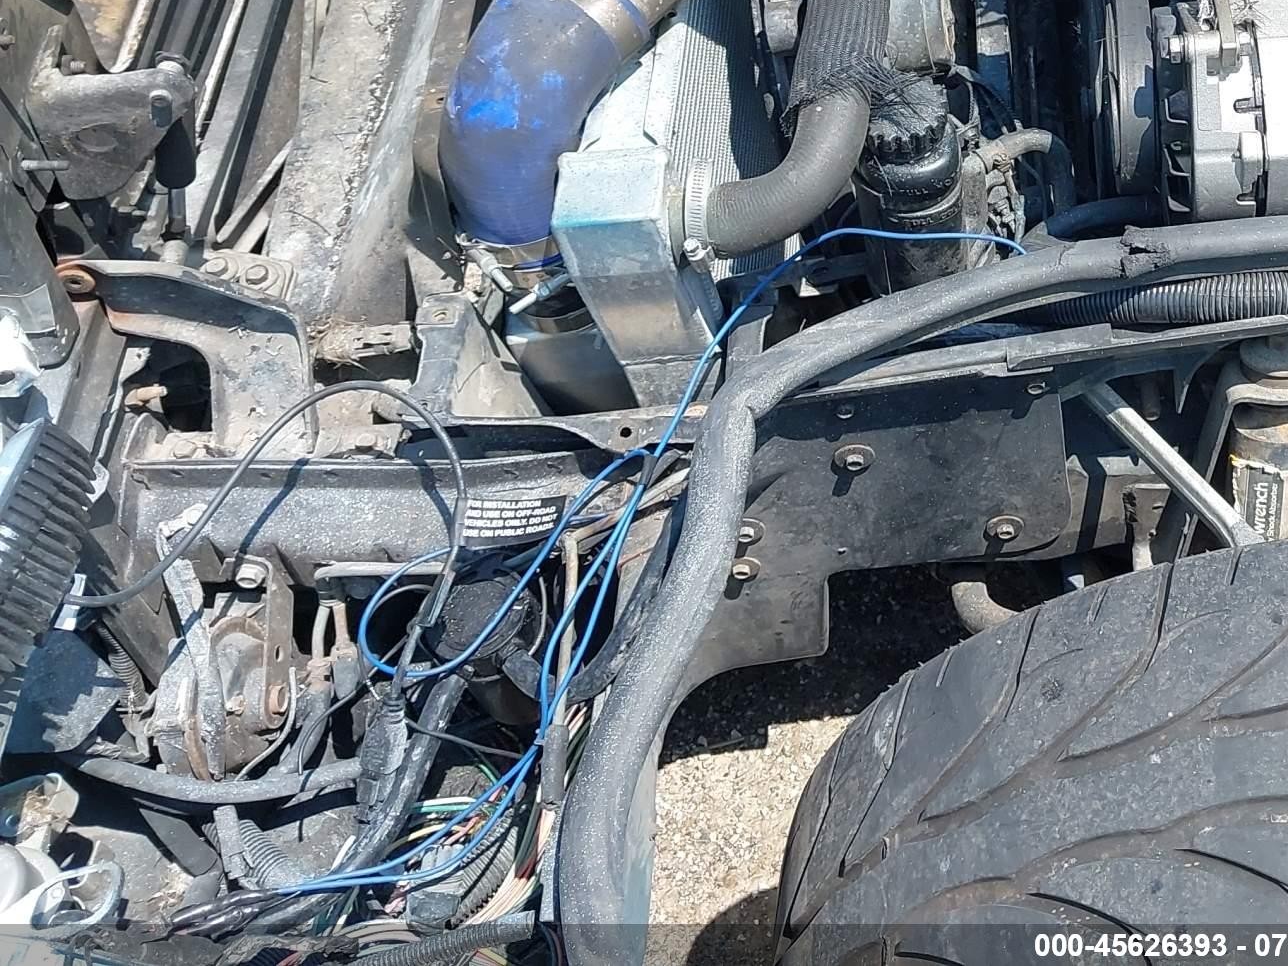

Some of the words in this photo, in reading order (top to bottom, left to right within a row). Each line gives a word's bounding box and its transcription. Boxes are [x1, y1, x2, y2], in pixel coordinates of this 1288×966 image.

[467, 500, 482, 508] FOR
[483, 500, 541, 508] INSTALLATION
[465, 509, 482, 517] AND
[482, 510, 501, 518] USE
[501, 510, 514, 518] ON
[516, 506, 556, 518] OFF-ROAD
[464, 518, 504, 527] VEHICLES
[505, 518, 527, 527] ONLY.
[542, 514, 558, 522] NOT
[463, 529, 479, 537] USE
[480, 529, 493, 537] ON
[495, 528, 525, 537] PUBLIC
[526, 522, 554, 534] ROADS.
